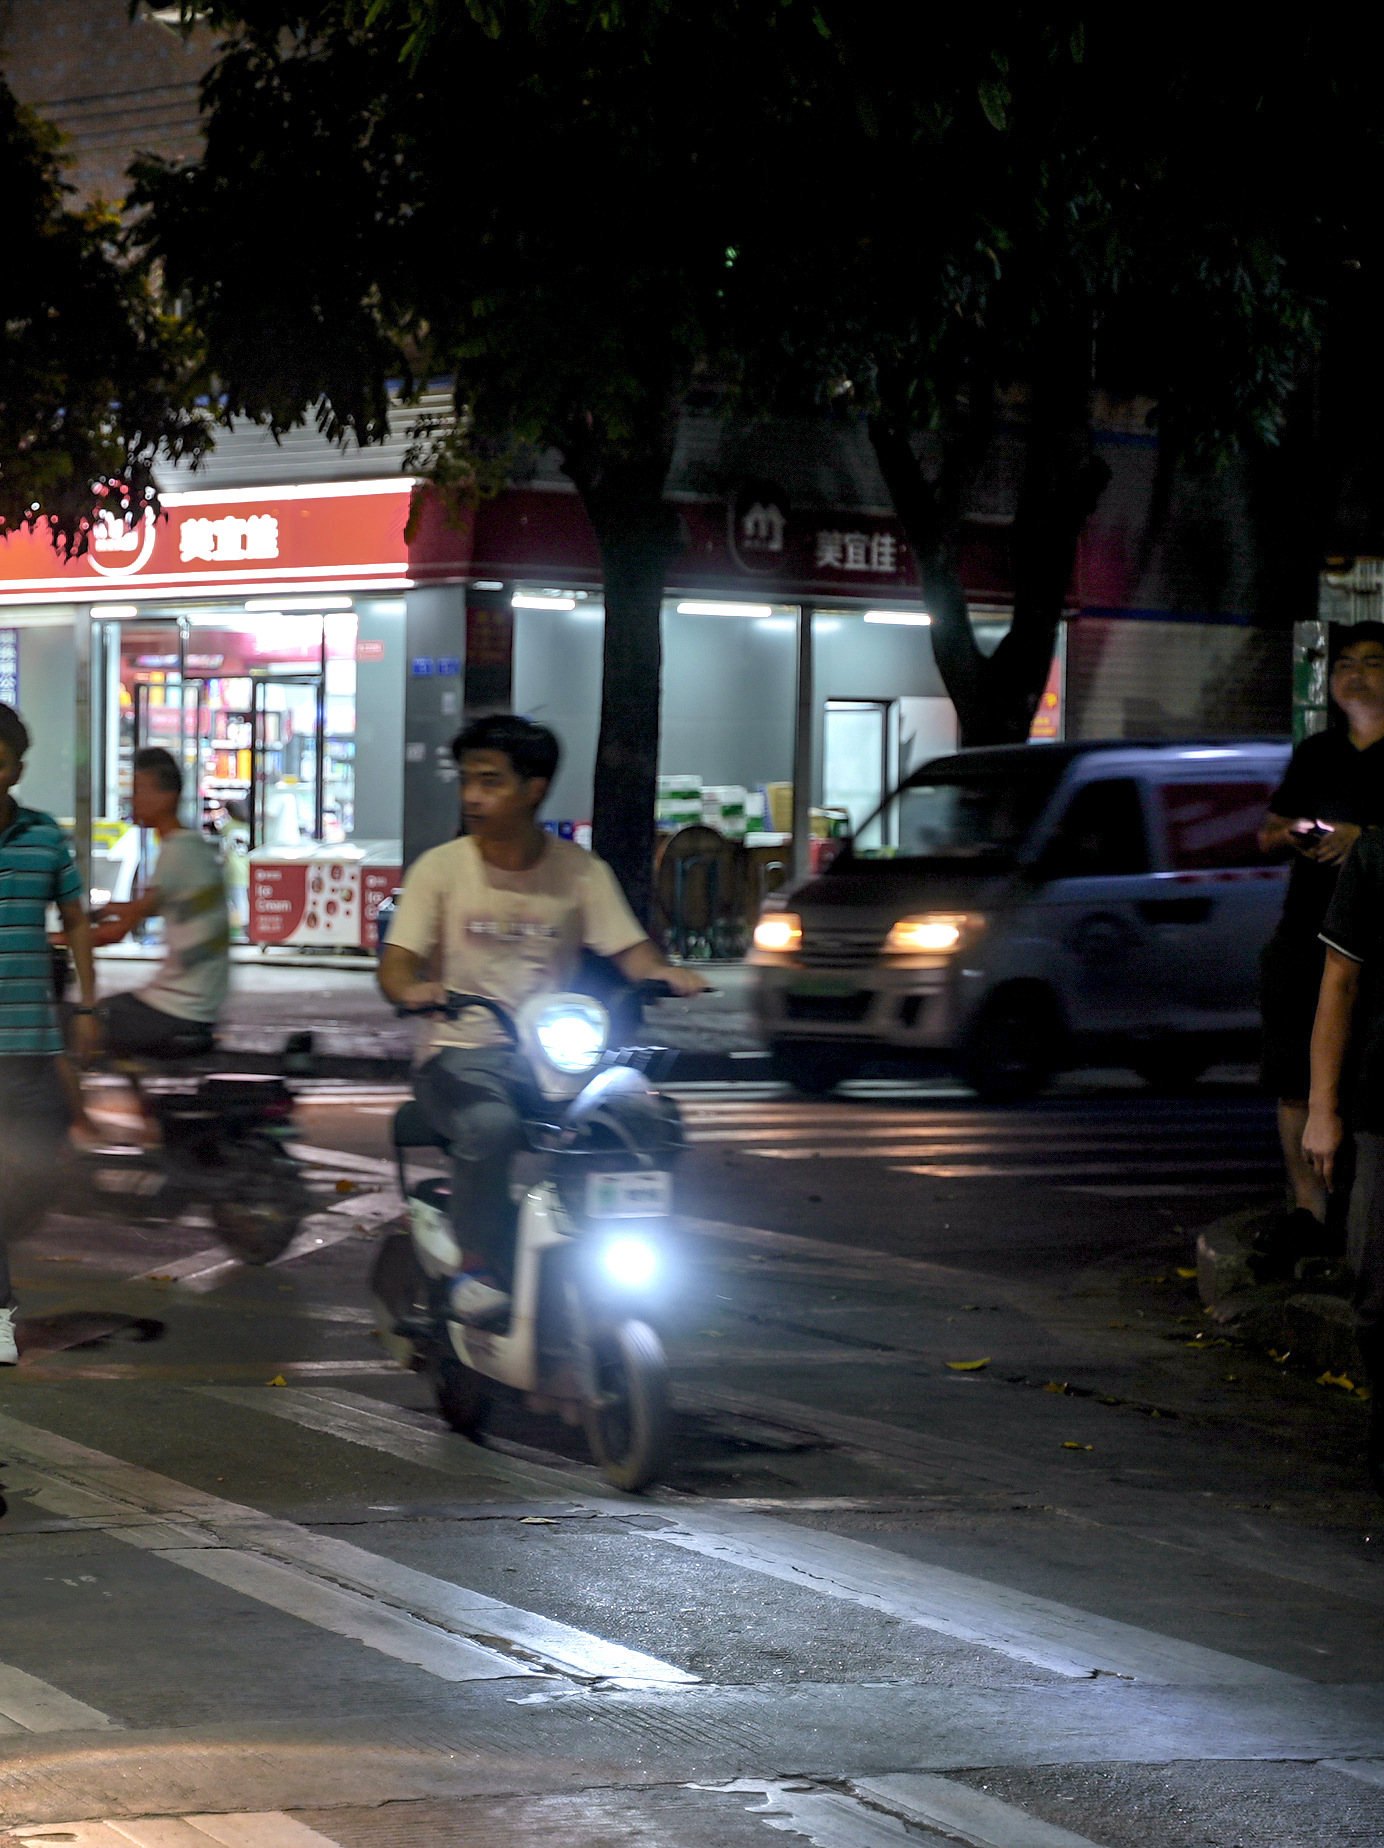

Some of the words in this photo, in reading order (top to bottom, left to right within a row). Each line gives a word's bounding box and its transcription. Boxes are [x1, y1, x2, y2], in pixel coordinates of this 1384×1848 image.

[179, 514, 280, 563] 美宜佳
[814, 528, 898, 574] 美宜佳
[256, 898, 293, 914] Cream
